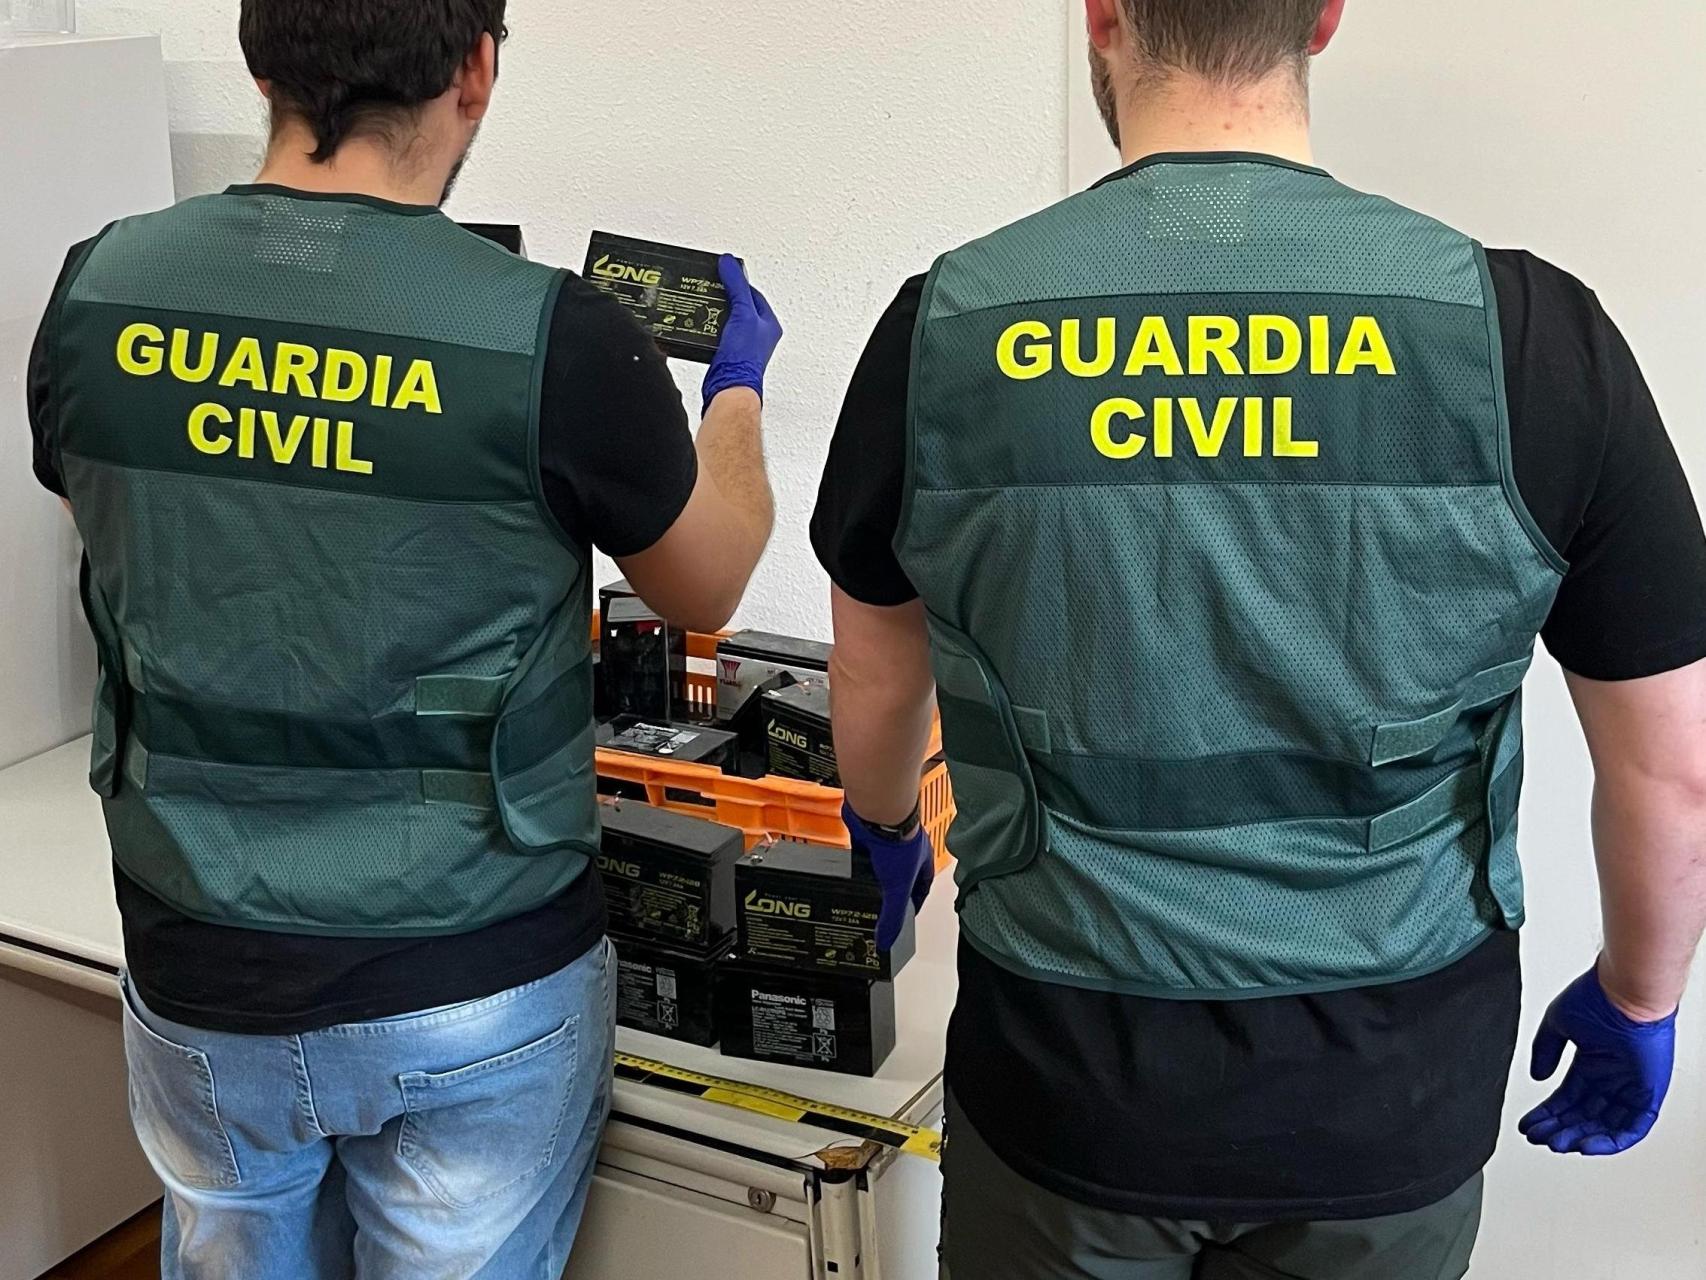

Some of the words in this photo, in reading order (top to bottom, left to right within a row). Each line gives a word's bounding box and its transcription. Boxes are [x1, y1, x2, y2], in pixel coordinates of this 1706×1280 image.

[592, 254, 662, 284] LONG
[703, 323, 718, 334] Pb
[995, 314, 1397, 380] GUARDIA
[116, 322, 443, 414] GUARDIA
[187, 402, 374, 475] CIVIL
[1090, 396, 1319, 459] CIVIL
[767, 717, 808, 749] LONG
[596, 855, 641, 878] ONG
[744, 889, 812, 918] LONG
[865, 956, 880, 968] Pb
[751, 989, 807, 1006] Panasonic
